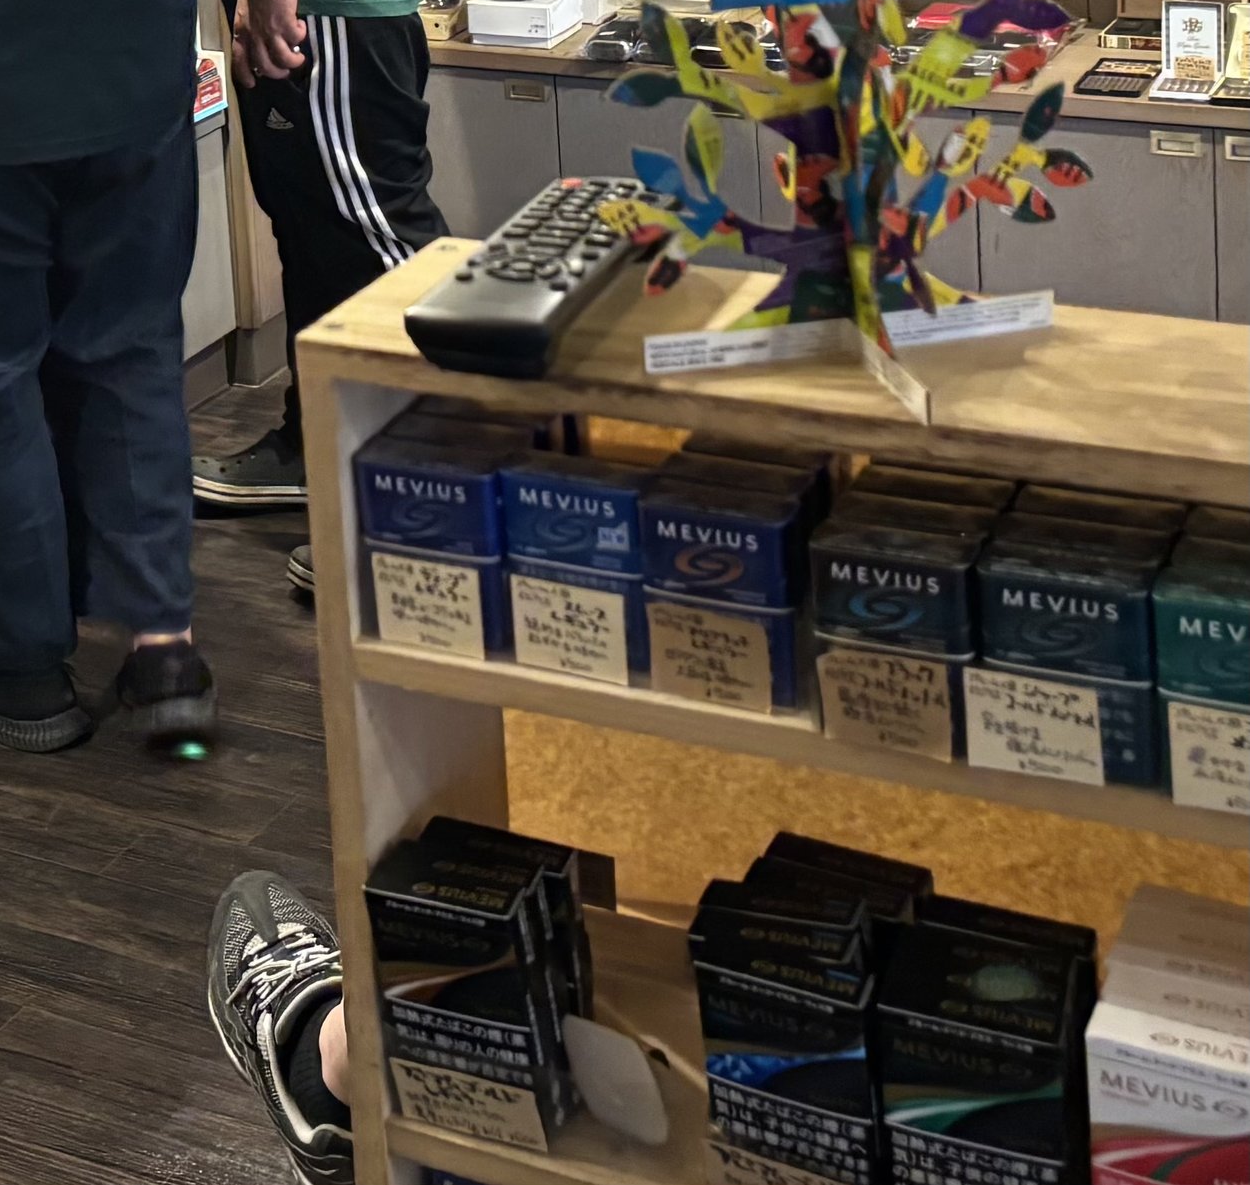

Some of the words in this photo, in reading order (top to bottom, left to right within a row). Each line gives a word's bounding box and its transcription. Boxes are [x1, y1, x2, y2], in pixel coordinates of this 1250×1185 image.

[374, 472, 468, 505] MEVIUS
[518, 486, 618, 518] MEVIUS
[657, 518, 760, 553] MEVIUS
[829, 560, 941, 596] MEVIUS
[1002, 587, 1121, 623] MEVIUS
[1100, 1069, 1207, 1112] MEVIUS
